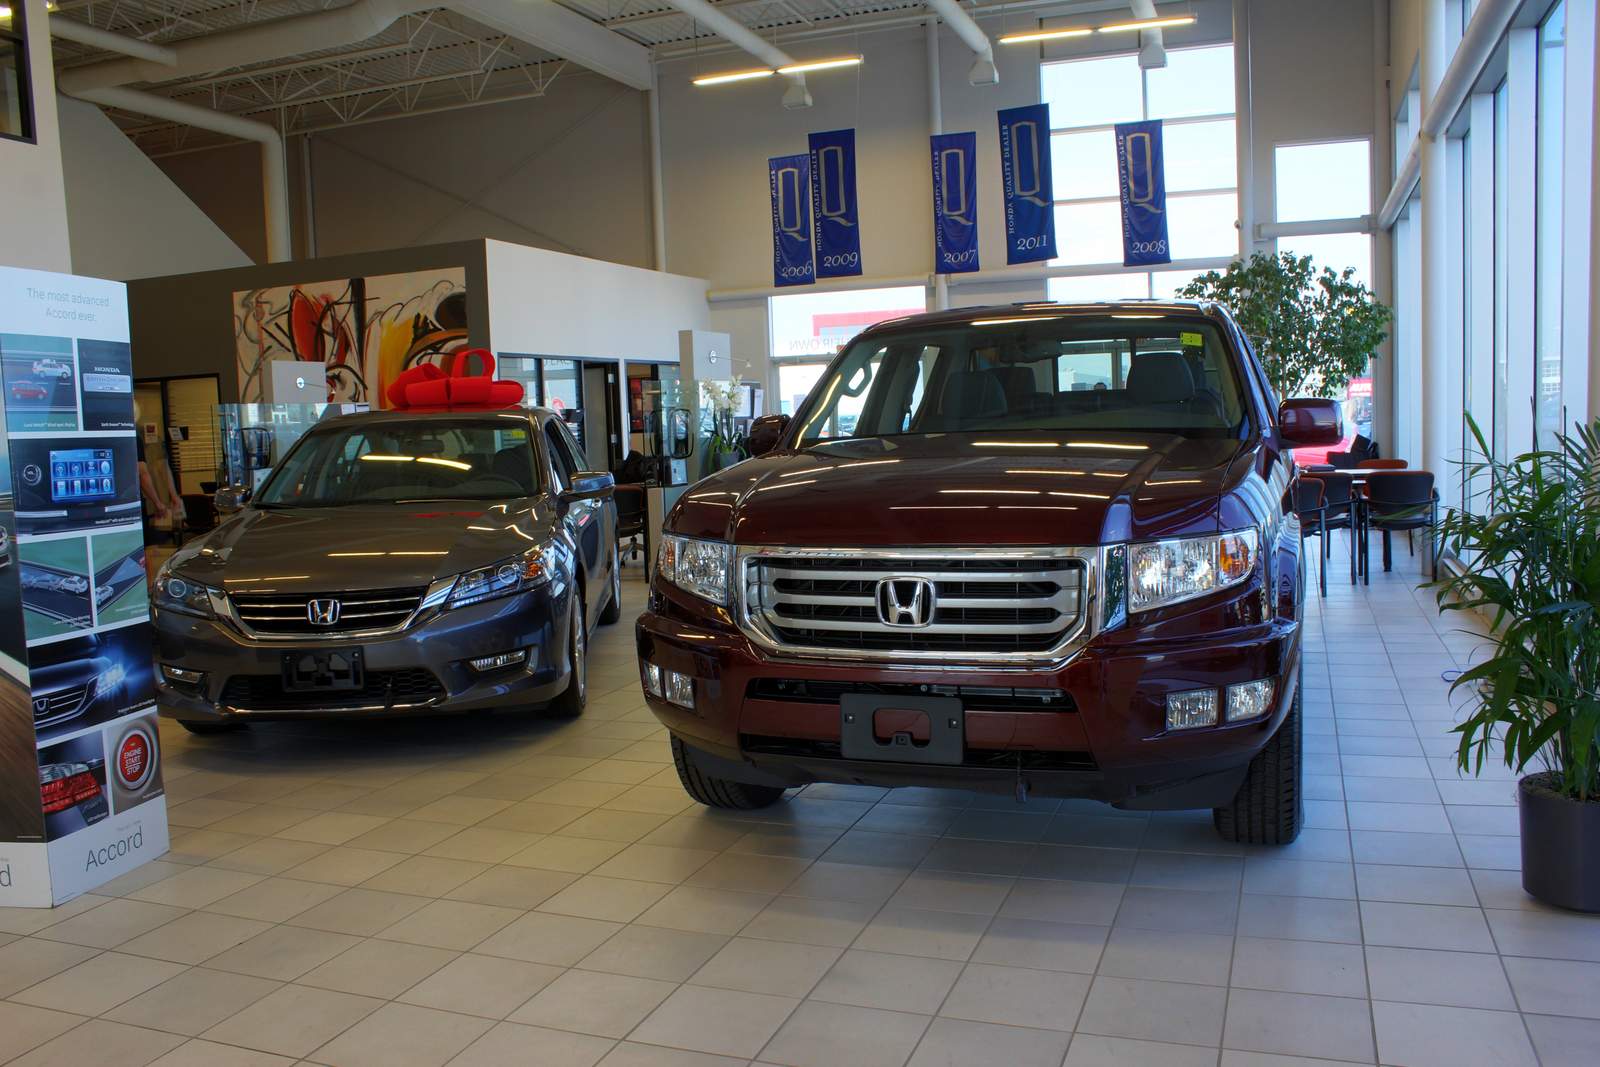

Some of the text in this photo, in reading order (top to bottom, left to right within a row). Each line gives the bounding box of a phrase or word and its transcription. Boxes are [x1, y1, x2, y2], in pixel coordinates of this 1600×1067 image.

[1002, 124, 1010, 158] DEALER
[1004, 161, 1014, 199] QUALITY
[1017, 235, 1047, 250] 2011
[1132, 240, 1166, 255] 2008
[823, 251, 858, 268] 2009
[943, 250, 976, 264] 2007
[782, 260, 813, 279] 2006
[26, 287, 110, 306] The most advanced
[46, 307, 76, 321] Accord
[125, 755, 141, 766] START
[126, 764, 141, 775] STOP
[85, 825, 144, 872] Accord
